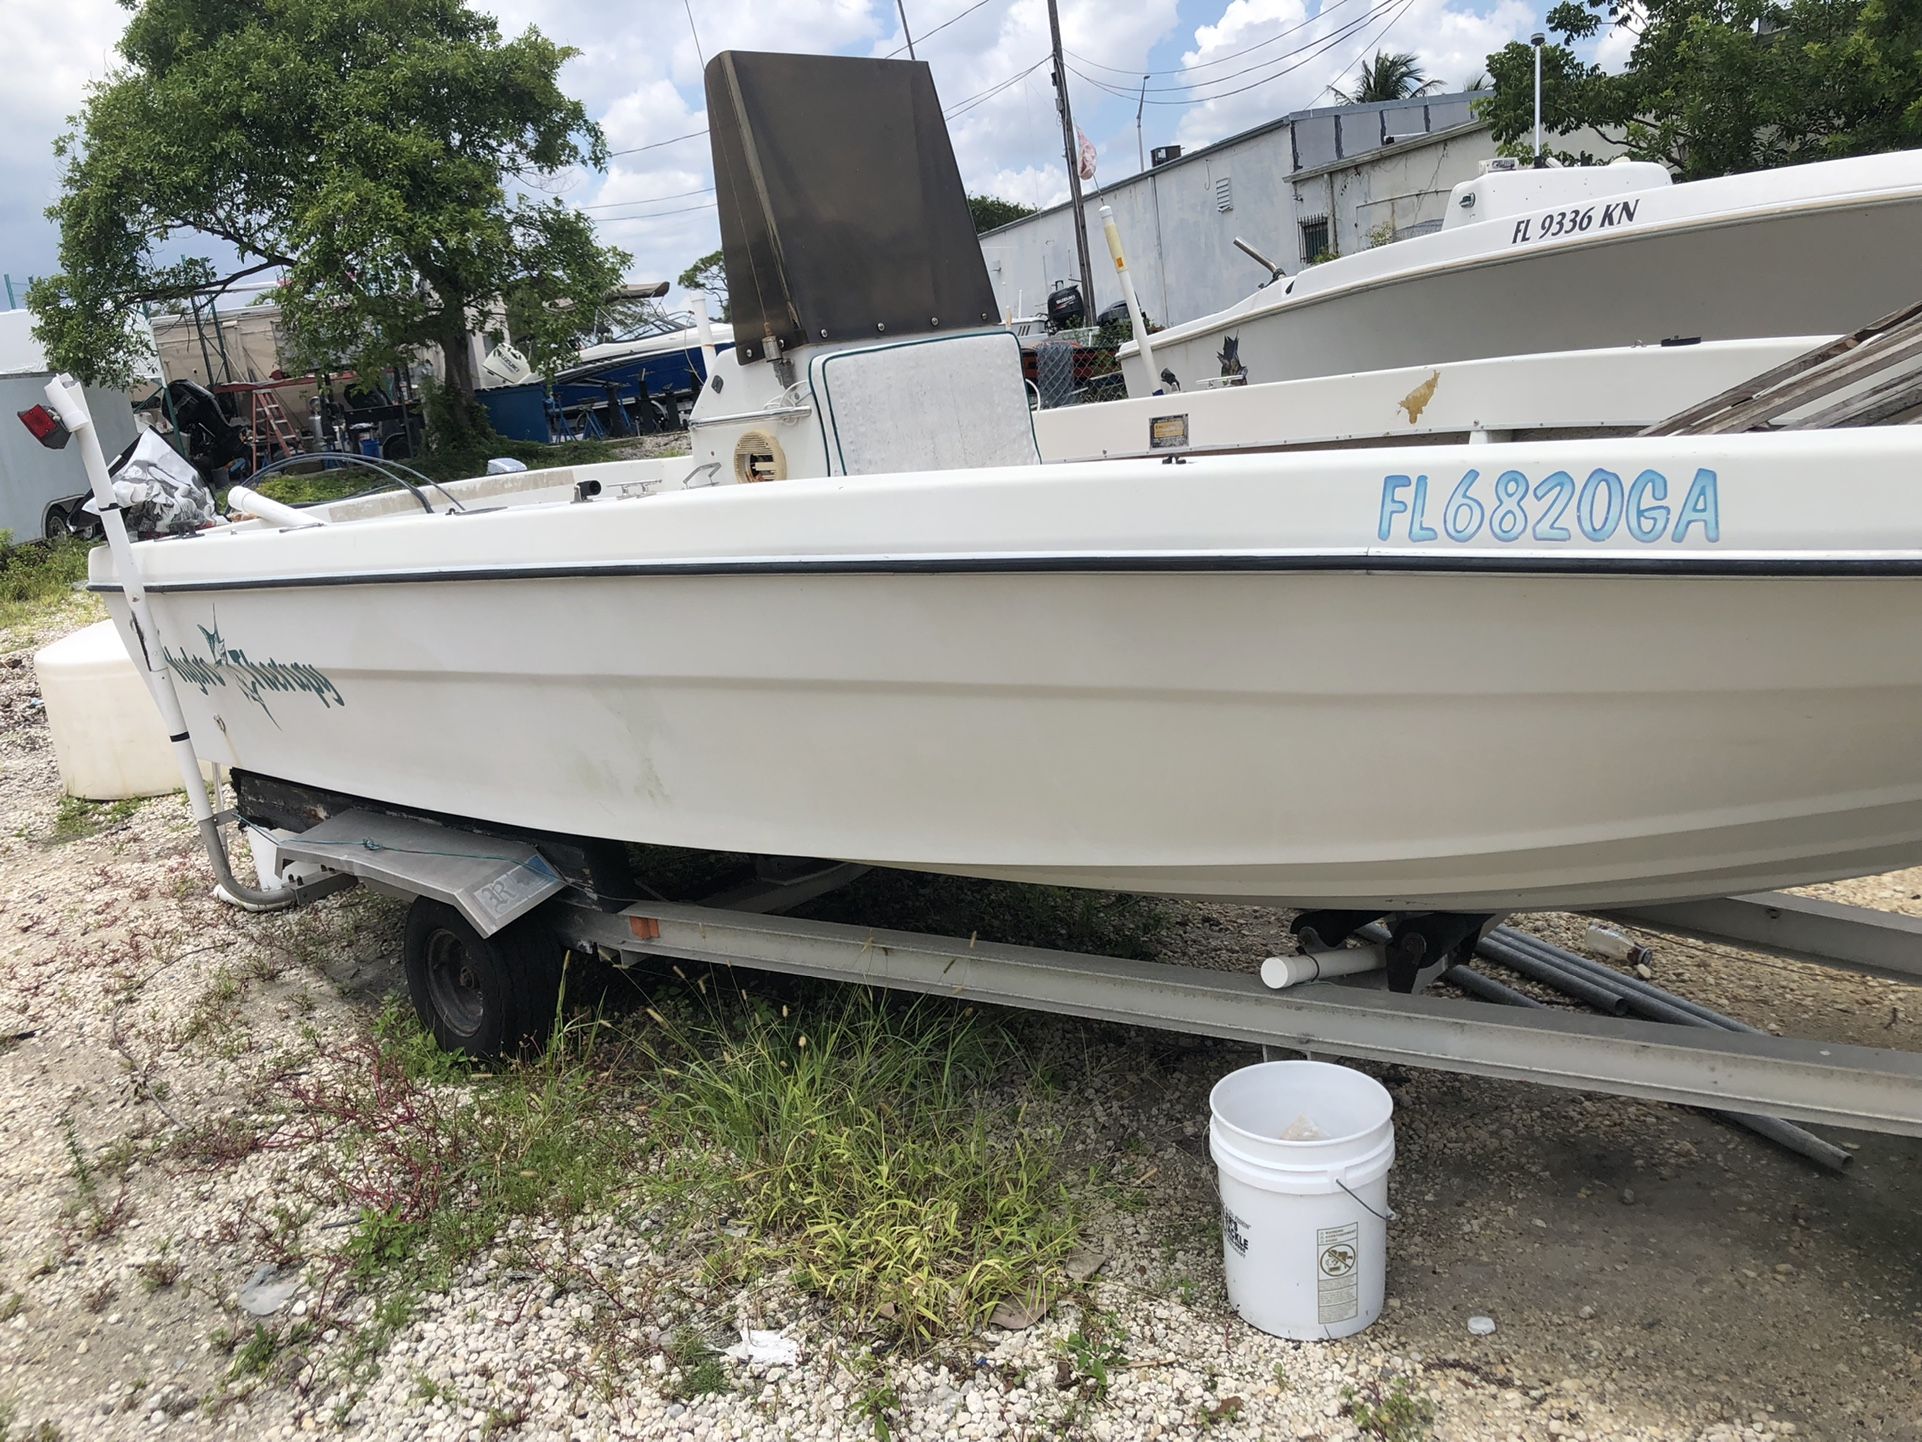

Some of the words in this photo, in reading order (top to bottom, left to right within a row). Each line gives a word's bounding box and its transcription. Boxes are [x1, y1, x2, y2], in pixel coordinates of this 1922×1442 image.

[1511, 218, 1532, 245] FL
[1538, 205, 1596, 240] 9336
[1599, 198, 1641, 229] KN
[1377, 467, 1720, 543] FL6820GA
[227, 649, 345, 708] Therapy
